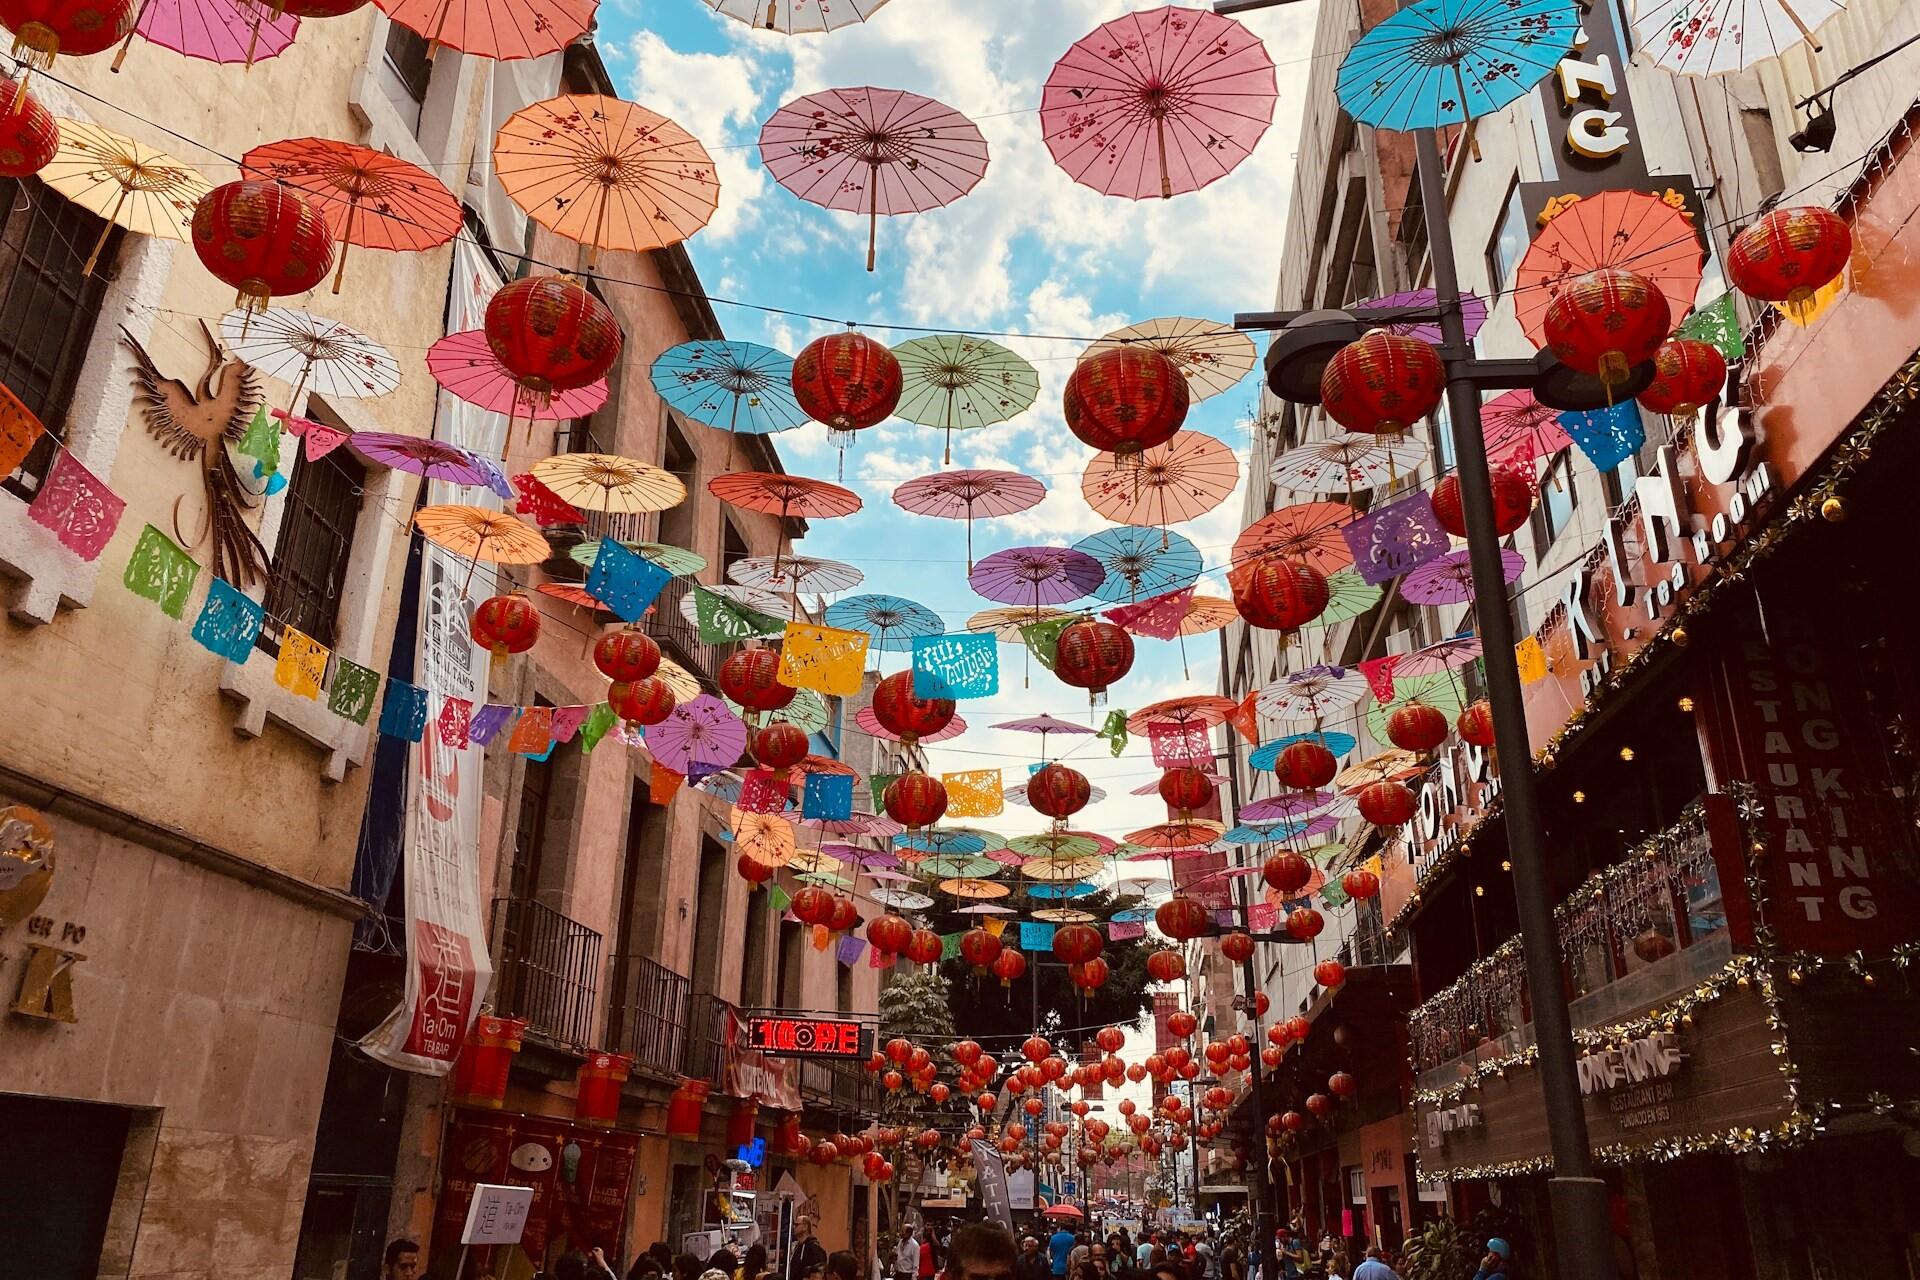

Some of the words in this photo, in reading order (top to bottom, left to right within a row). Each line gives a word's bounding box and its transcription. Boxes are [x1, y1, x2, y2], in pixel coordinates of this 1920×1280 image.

[1643, 562, 1688, 620] Tea
[1692, 461, 1771, 566] Room
[1579, 648, 1609, 697] Bar
[1740, 638, 1824, 922] ESTAURANT
[1810, 767, 1878, 920] KING
[1610, 1090, 1655, 1113] RESTAURANT
[1656, 1084, 1673, 1104] BAR
